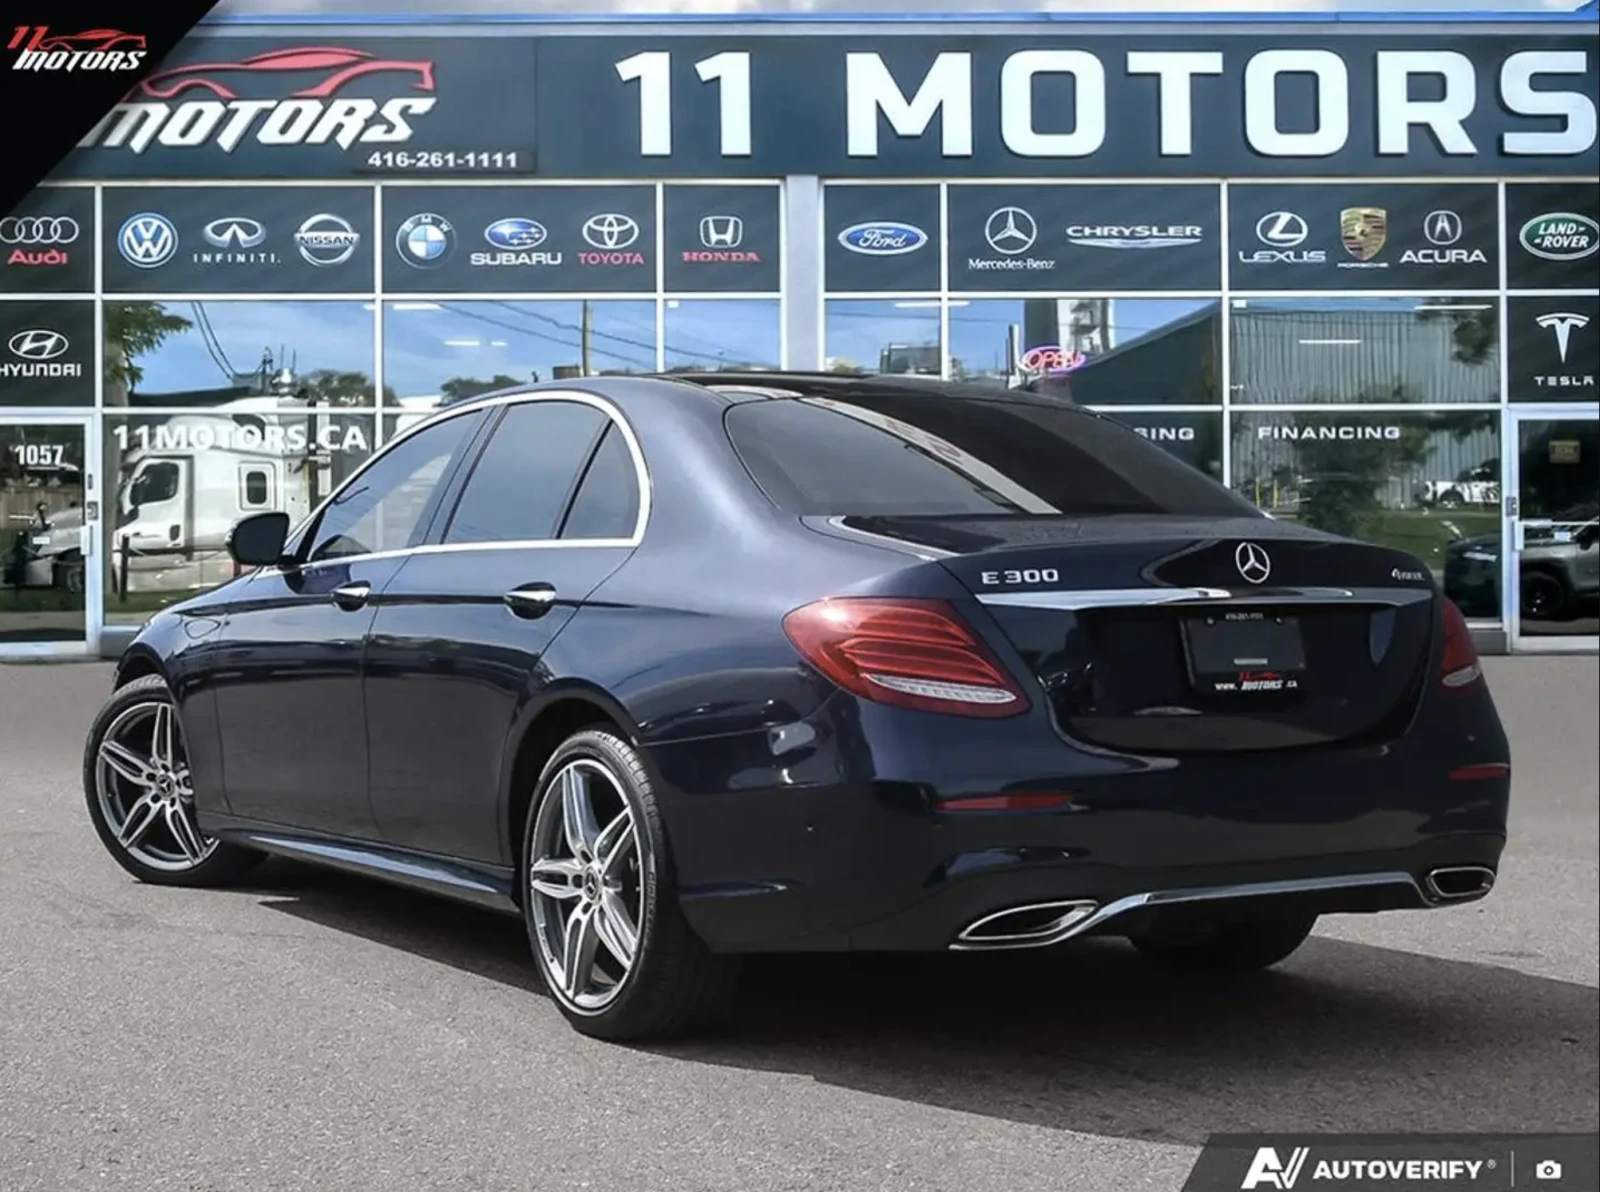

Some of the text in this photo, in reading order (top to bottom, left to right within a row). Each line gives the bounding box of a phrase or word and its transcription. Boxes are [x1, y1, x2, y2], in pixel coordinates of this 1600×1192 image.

[614, 48, 1597, 157] 11 MOTORS
[76, 97, 437, 154] MOTORS
[367, 151, 517, 169] 416-261-1111
[1066, 225, 1202, 238] CHRYSLER
[1538, 222, 1577, 235] LAND
[299, 234, 353, 247] NISSAN
[858, 229, 907, 248] Ford
[1542, 236, 1590, 249] ROVER
[470, 252, 562, 266] SUBARU
[579, 252, 644, 265] TOYOTA
[682, 252, 760, 263] HONDA
[1239, 251, 1326, 263] LEXUS
[1400, 249, 1487, 263] ACURA
[968, 258, 1055, 270] Mercedes-Benz
[0, 363, 82, 377] HYUNDAI
[1534, 376, 1594, 386] TESLA
[113, 425, 368, 450] 11MOTORS.CA
[1257, 426, 1400, 440] FINANCING
[15, 446, 63, 465] 1057
[981, 569, 1059, 584] E 300
